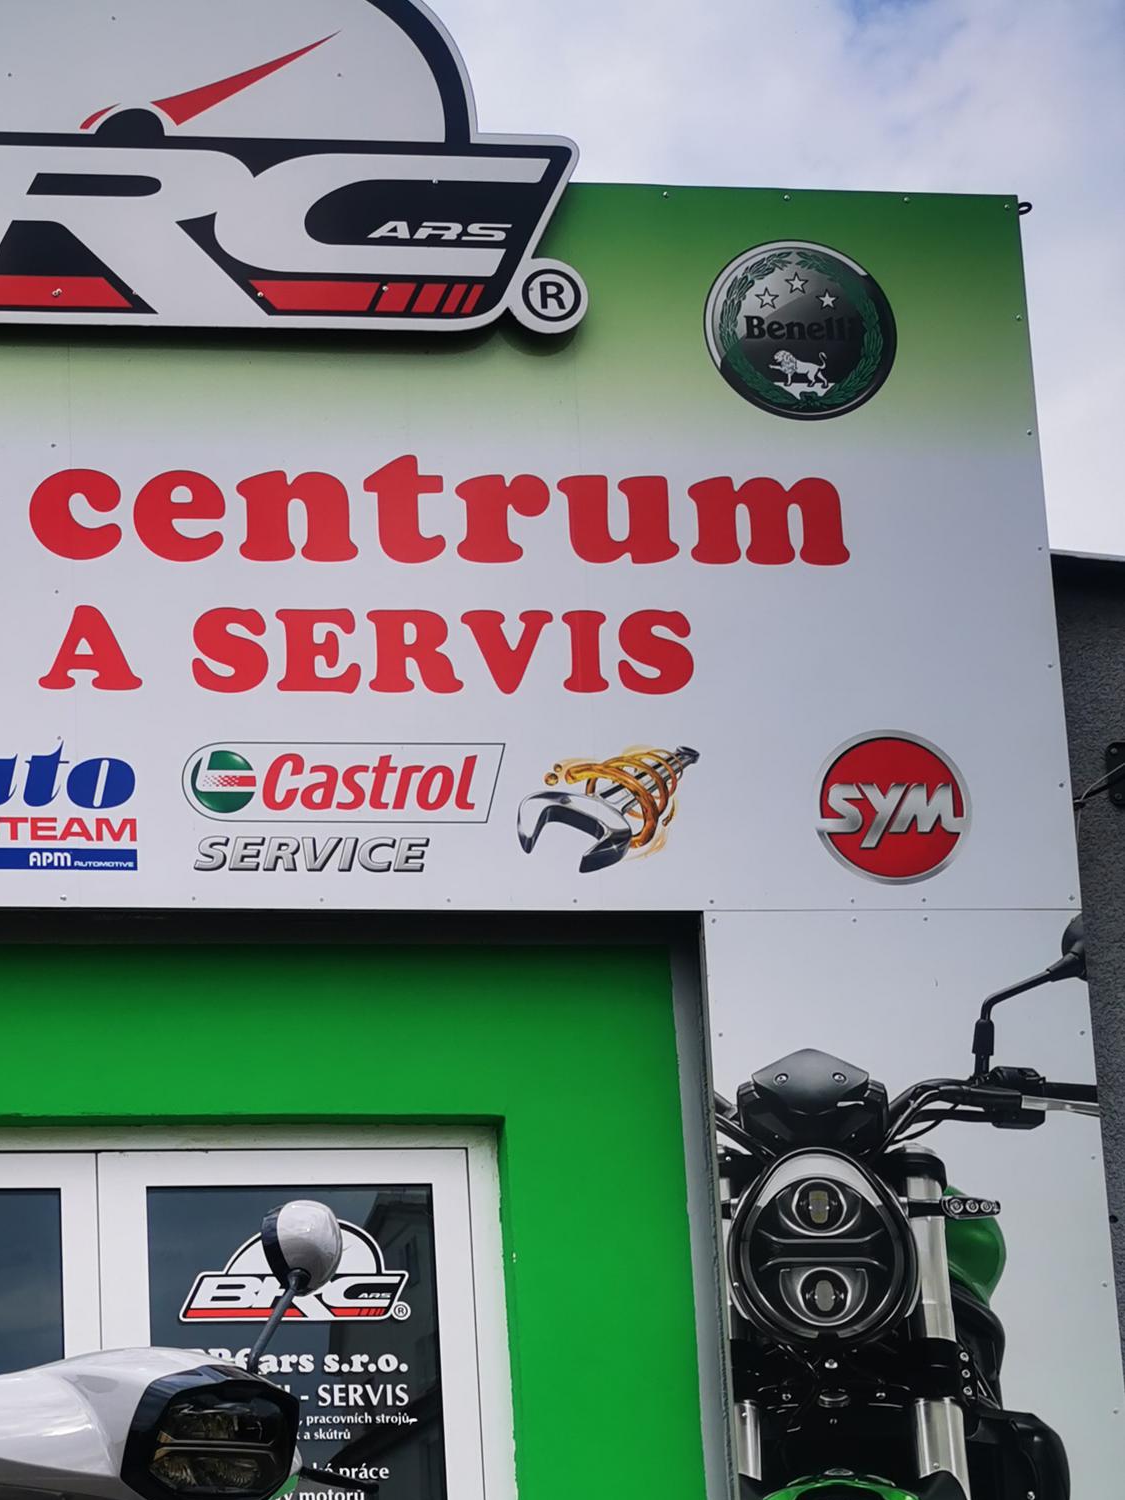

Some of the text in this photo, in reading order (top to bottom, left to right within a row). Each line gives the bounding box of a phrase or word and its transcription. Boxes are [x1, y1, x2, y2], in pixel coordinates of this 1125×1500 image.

[366, 219, 513, 244] ARS
[29, 454, 851, 567] centrum
[38, 604, 143, 691] A
[191, 606, 695, 695] SERVIS
[260, 752, 479, 813] Castrol
[817, 783, 965, 849] SYM
[28, 851, 135, 868] APM AUTOMOTIVE
[192, 835, 431, 873] SERVICE
[323, 1353, 409, 1373] s.r.o.
[317, 1383, 410, 1407] SERVIS
[306, 1412, 373, 1427] pracovních
[303, 1431, 311, 1440] a
[314, 1428, 351, 1440] skútrů
